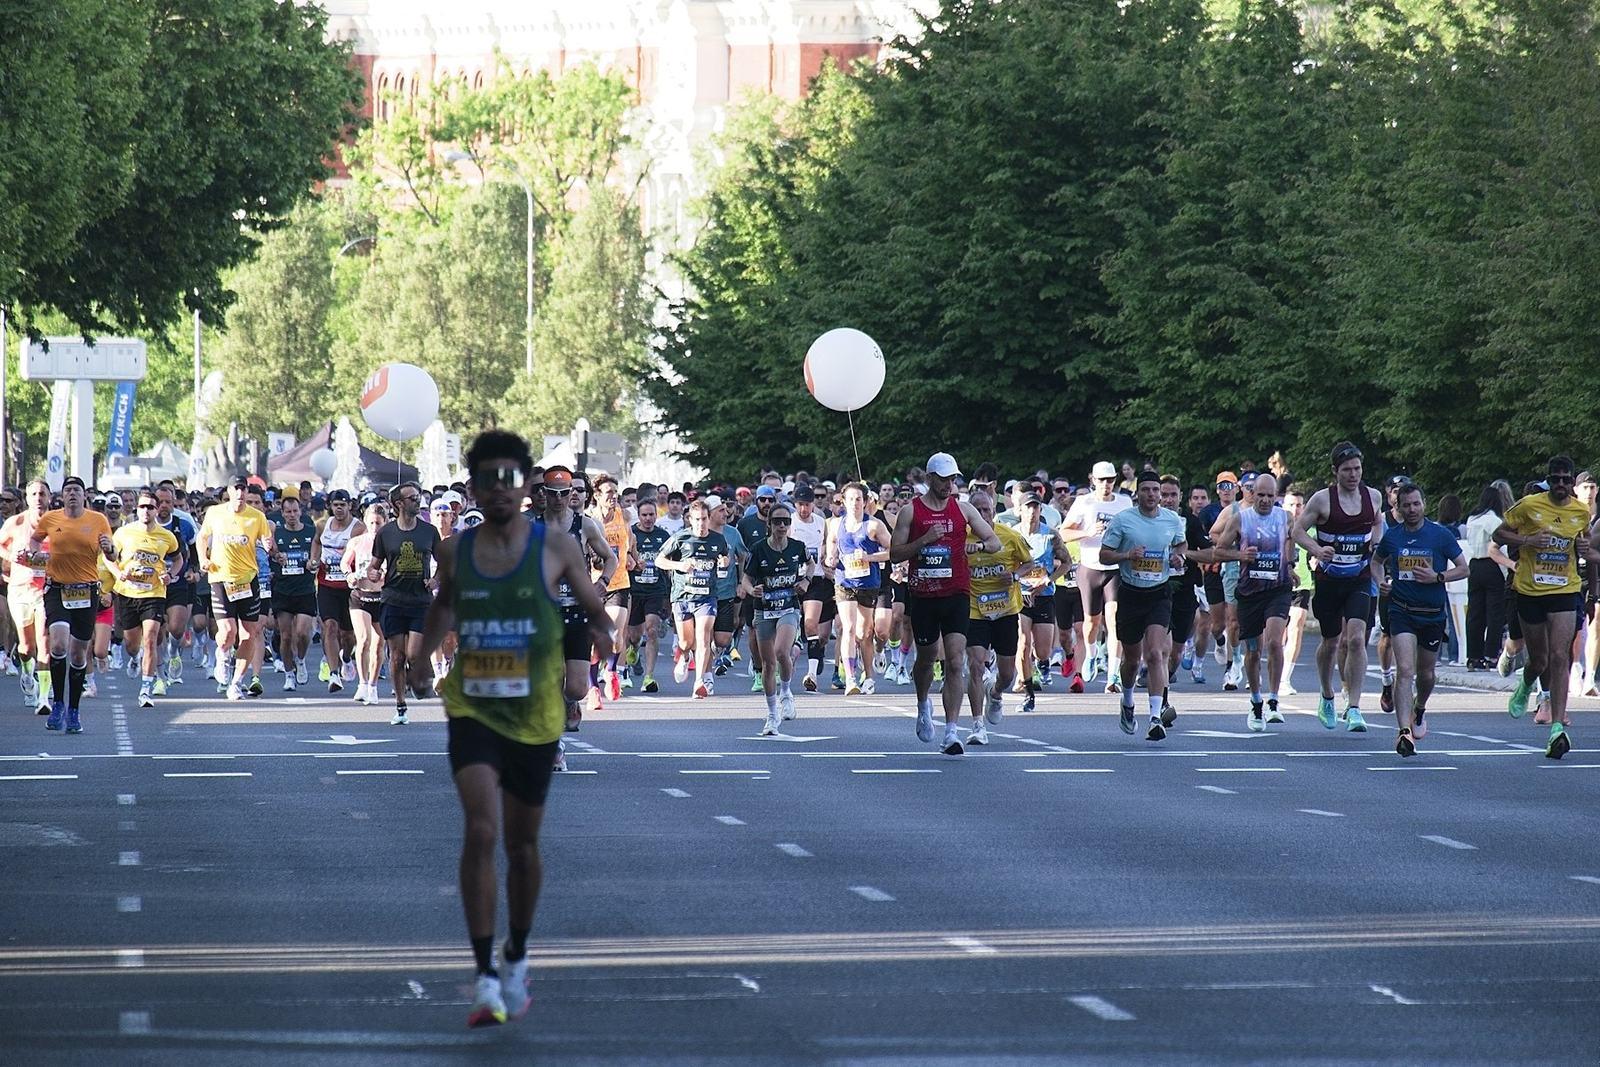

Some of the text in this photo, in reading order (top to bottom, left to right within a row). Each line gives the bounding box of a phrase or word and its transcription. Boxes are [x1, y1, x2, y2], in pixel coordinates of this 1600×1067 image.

[114, 393, 129, 448] ZURICH
[1342, 544, 1357, 552] 1781
[925, 556, 943, 566] 3057
[1138, 560, 1158, 569] 23871
[1257, 561, 1274, 569] 2565
[973, 564, 1005, 579] MADRID
[460, 619, 538, 635] BRASIL
